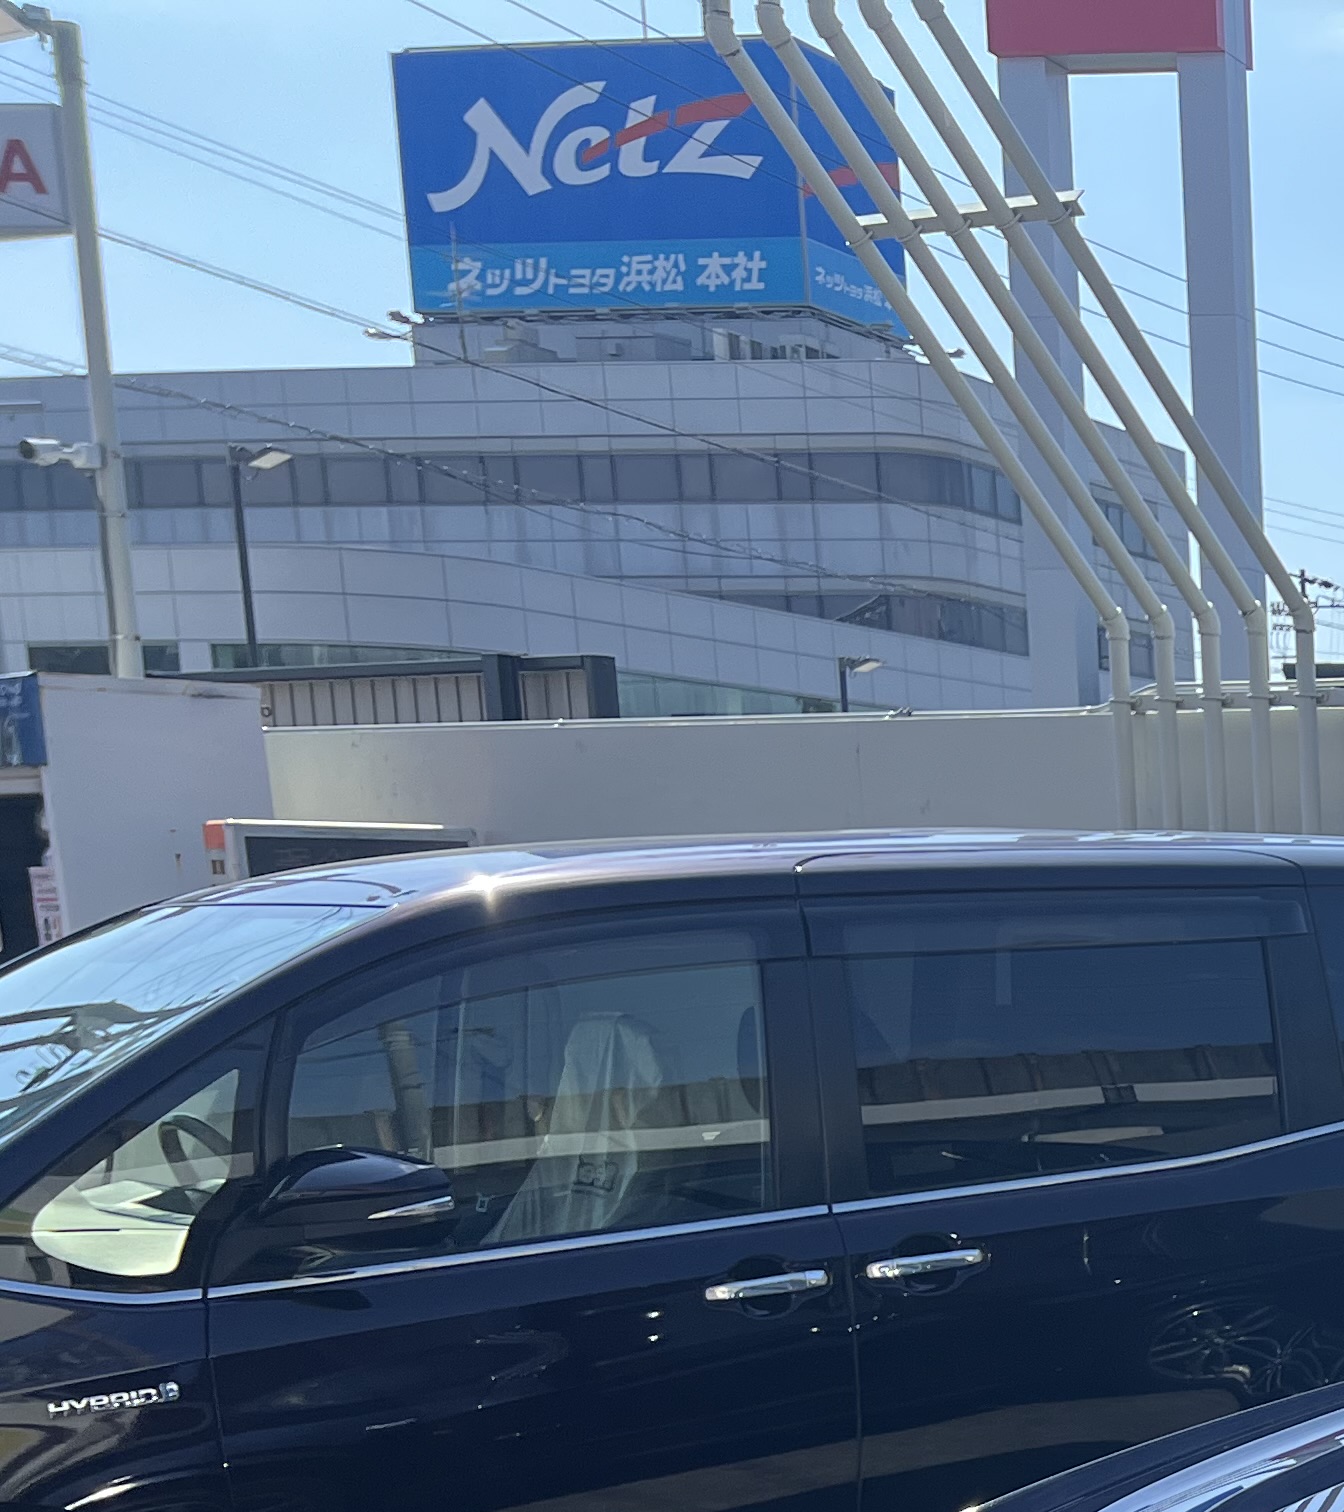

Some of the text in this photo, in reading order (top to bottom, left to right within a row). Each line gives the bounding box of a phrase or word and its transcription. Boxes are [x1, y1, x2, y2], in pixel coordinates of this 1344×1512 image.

[0, 139, 49, 194] A
[427, 80, 764, 213] Netz
[448, 250, 767, 297] ネッツトヨタ浜松 本社
